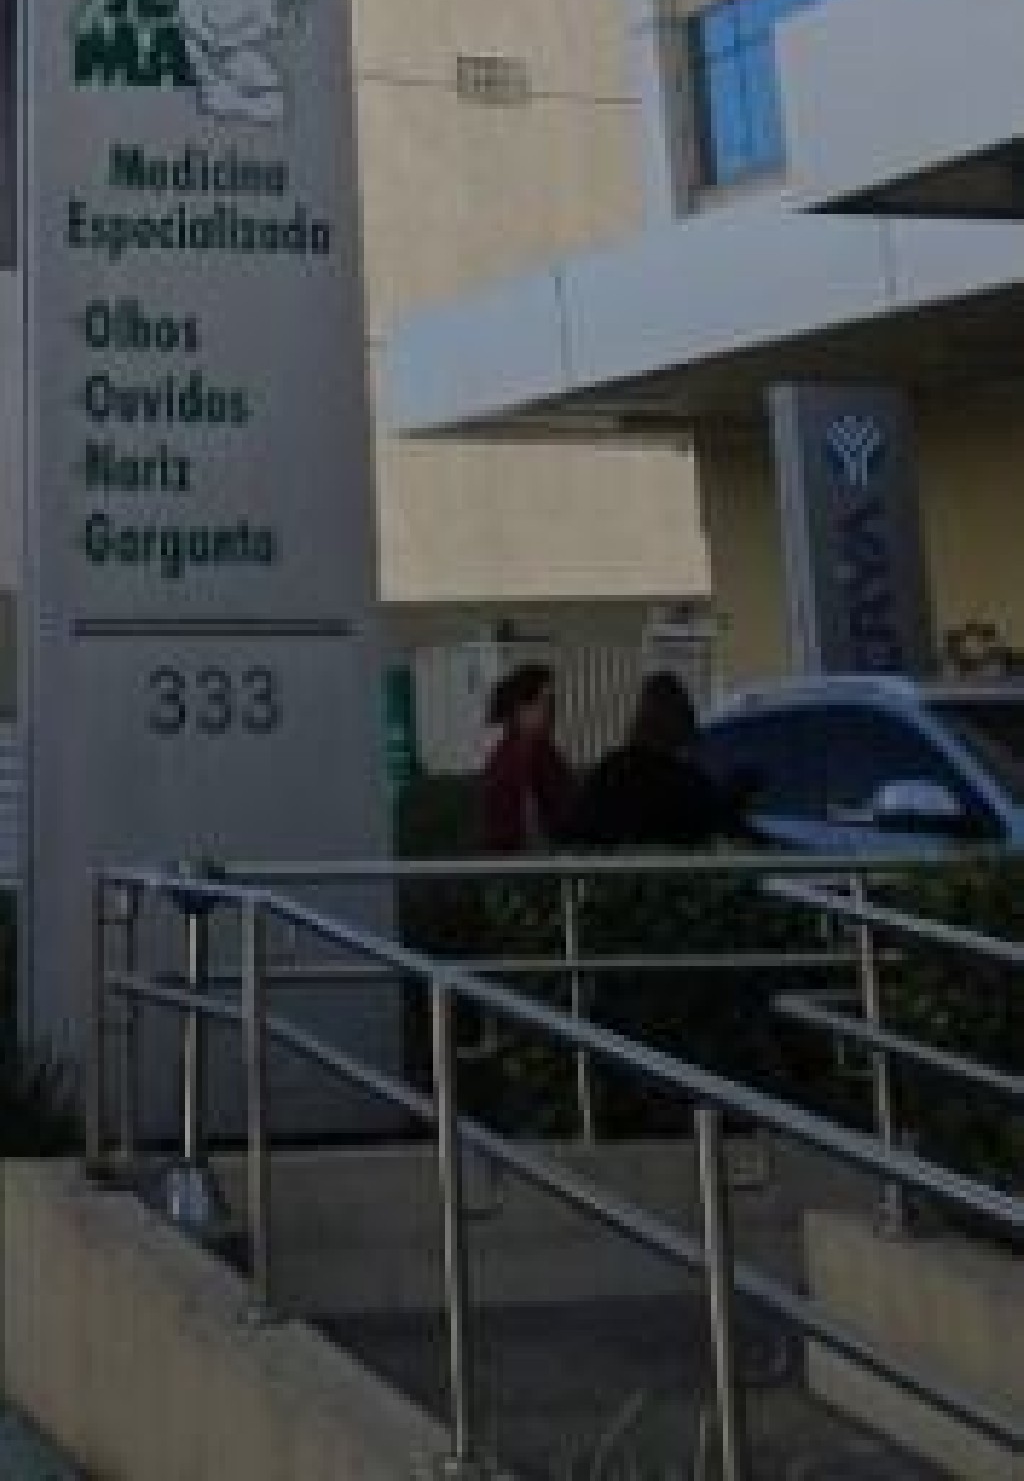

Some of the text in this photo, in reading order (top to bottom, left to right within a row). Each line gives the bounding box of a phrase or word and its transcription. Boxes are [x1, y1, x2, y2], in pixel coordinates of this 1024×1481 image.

[75, 26, 198, 88] MA
[110, 145, 288, 195] Medicina
[69, 200, 332, 260] Especializada
[149, 665, 282, 735] 333
